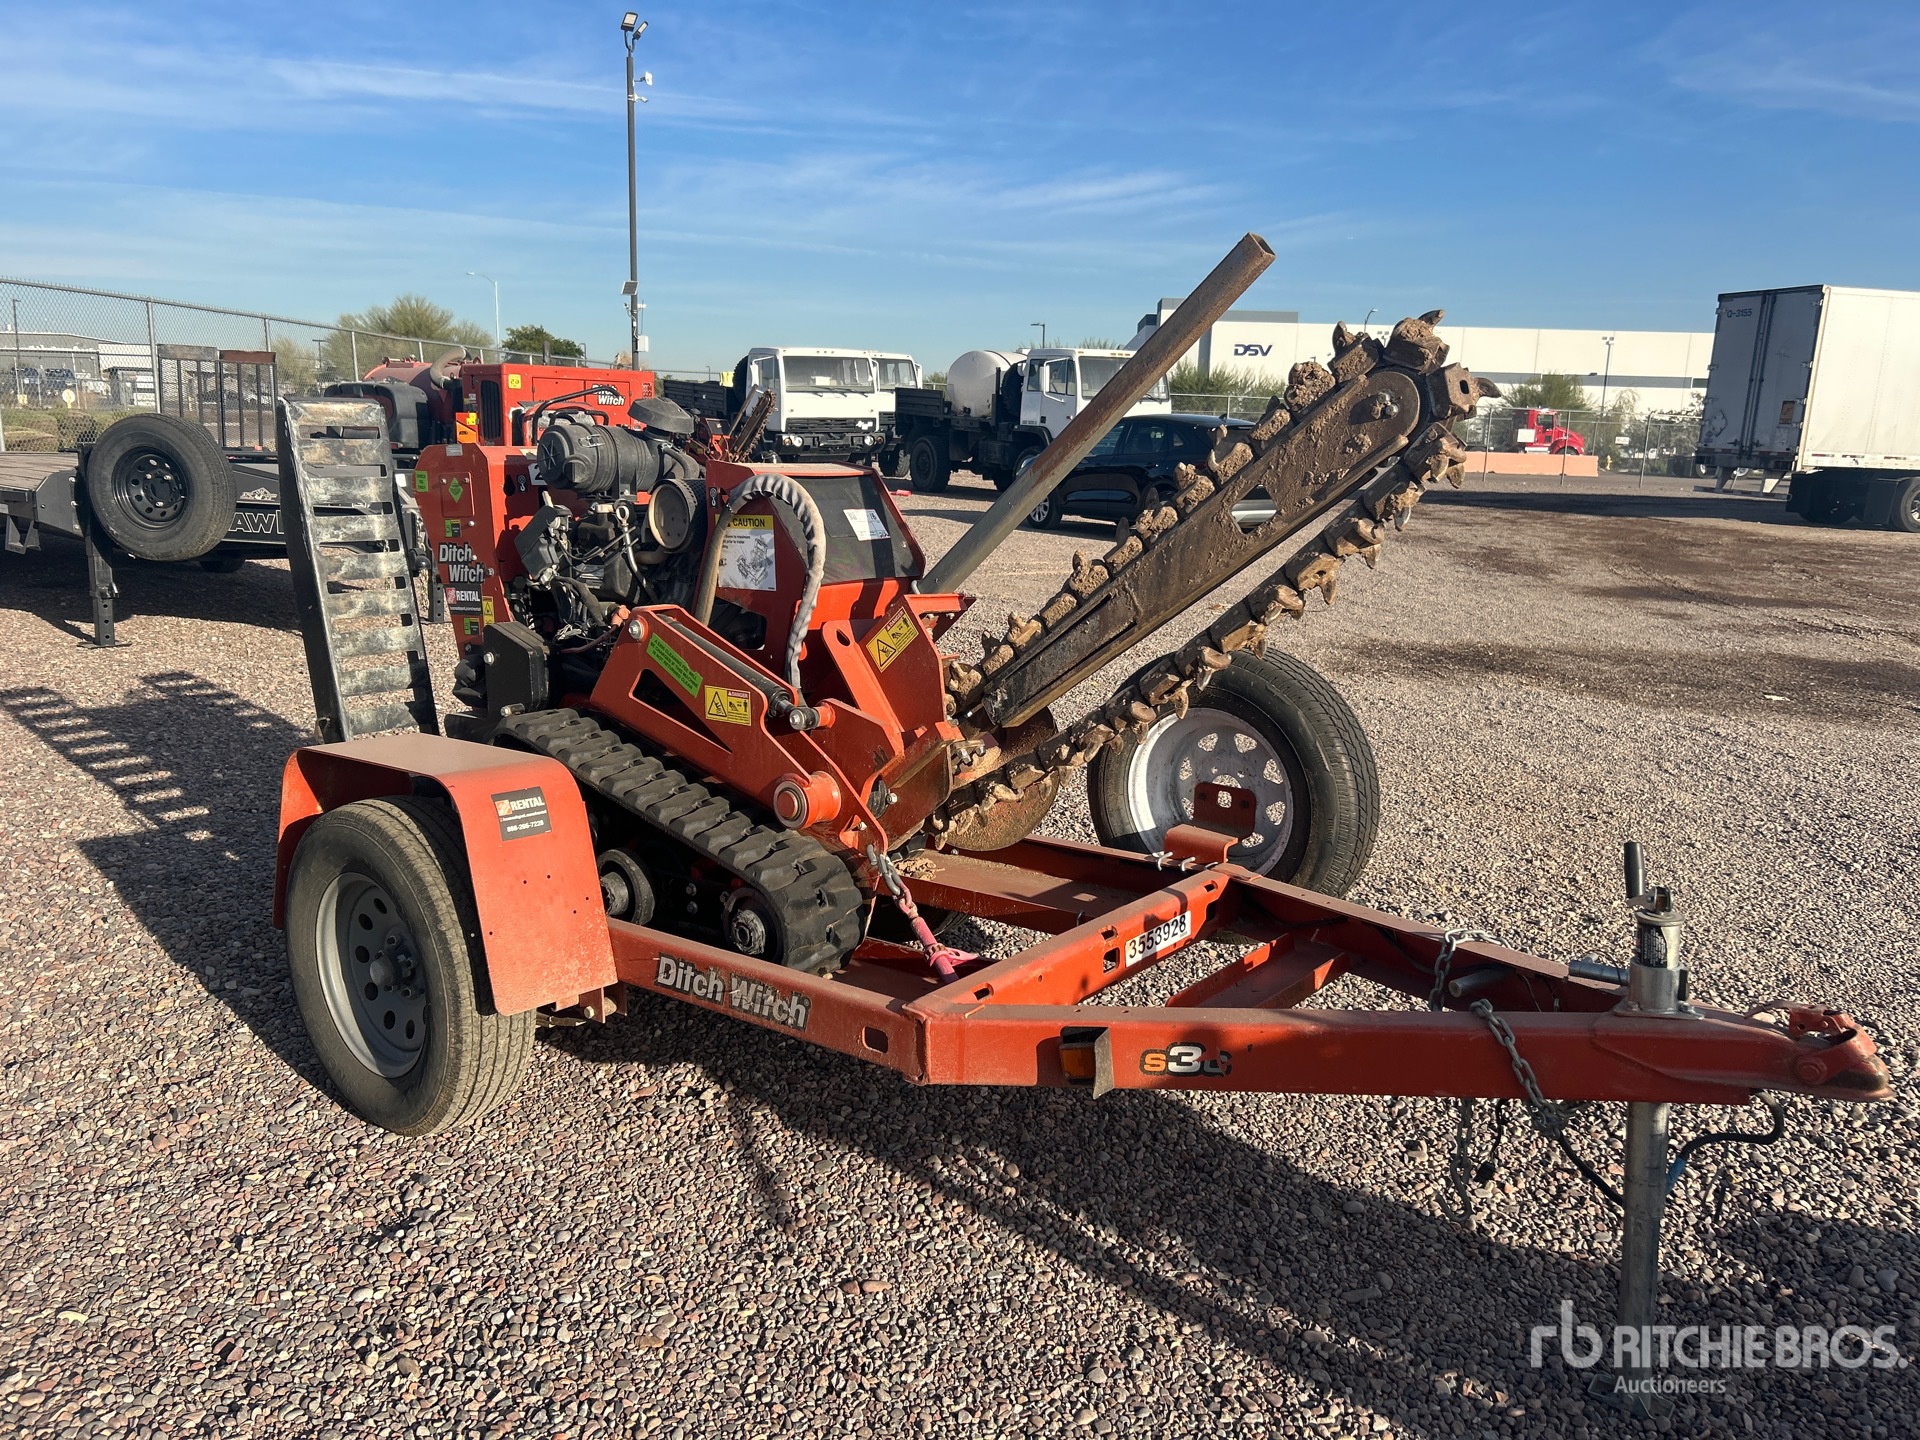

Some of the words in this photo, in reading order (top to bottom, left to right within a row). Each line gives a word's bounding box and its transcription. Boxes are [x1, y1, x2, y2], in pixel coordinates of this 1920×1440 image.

[1234, 344, 1273, 357] DSV
[598, 394, 625, 406] Witch
[733, 518, 766, 528] CAUTION
[439, 543, 472, 562] Ditch
[449, 563, 484, 582] Witch
[455, 590, 480, 602] RENTAL
[510, 796, 545, 811] RENTAL
[1128, 914, 1187, 959] 3553928
[657, 956, 724, 1003] Ditch
[730, 976, 806, 1028] Witch
